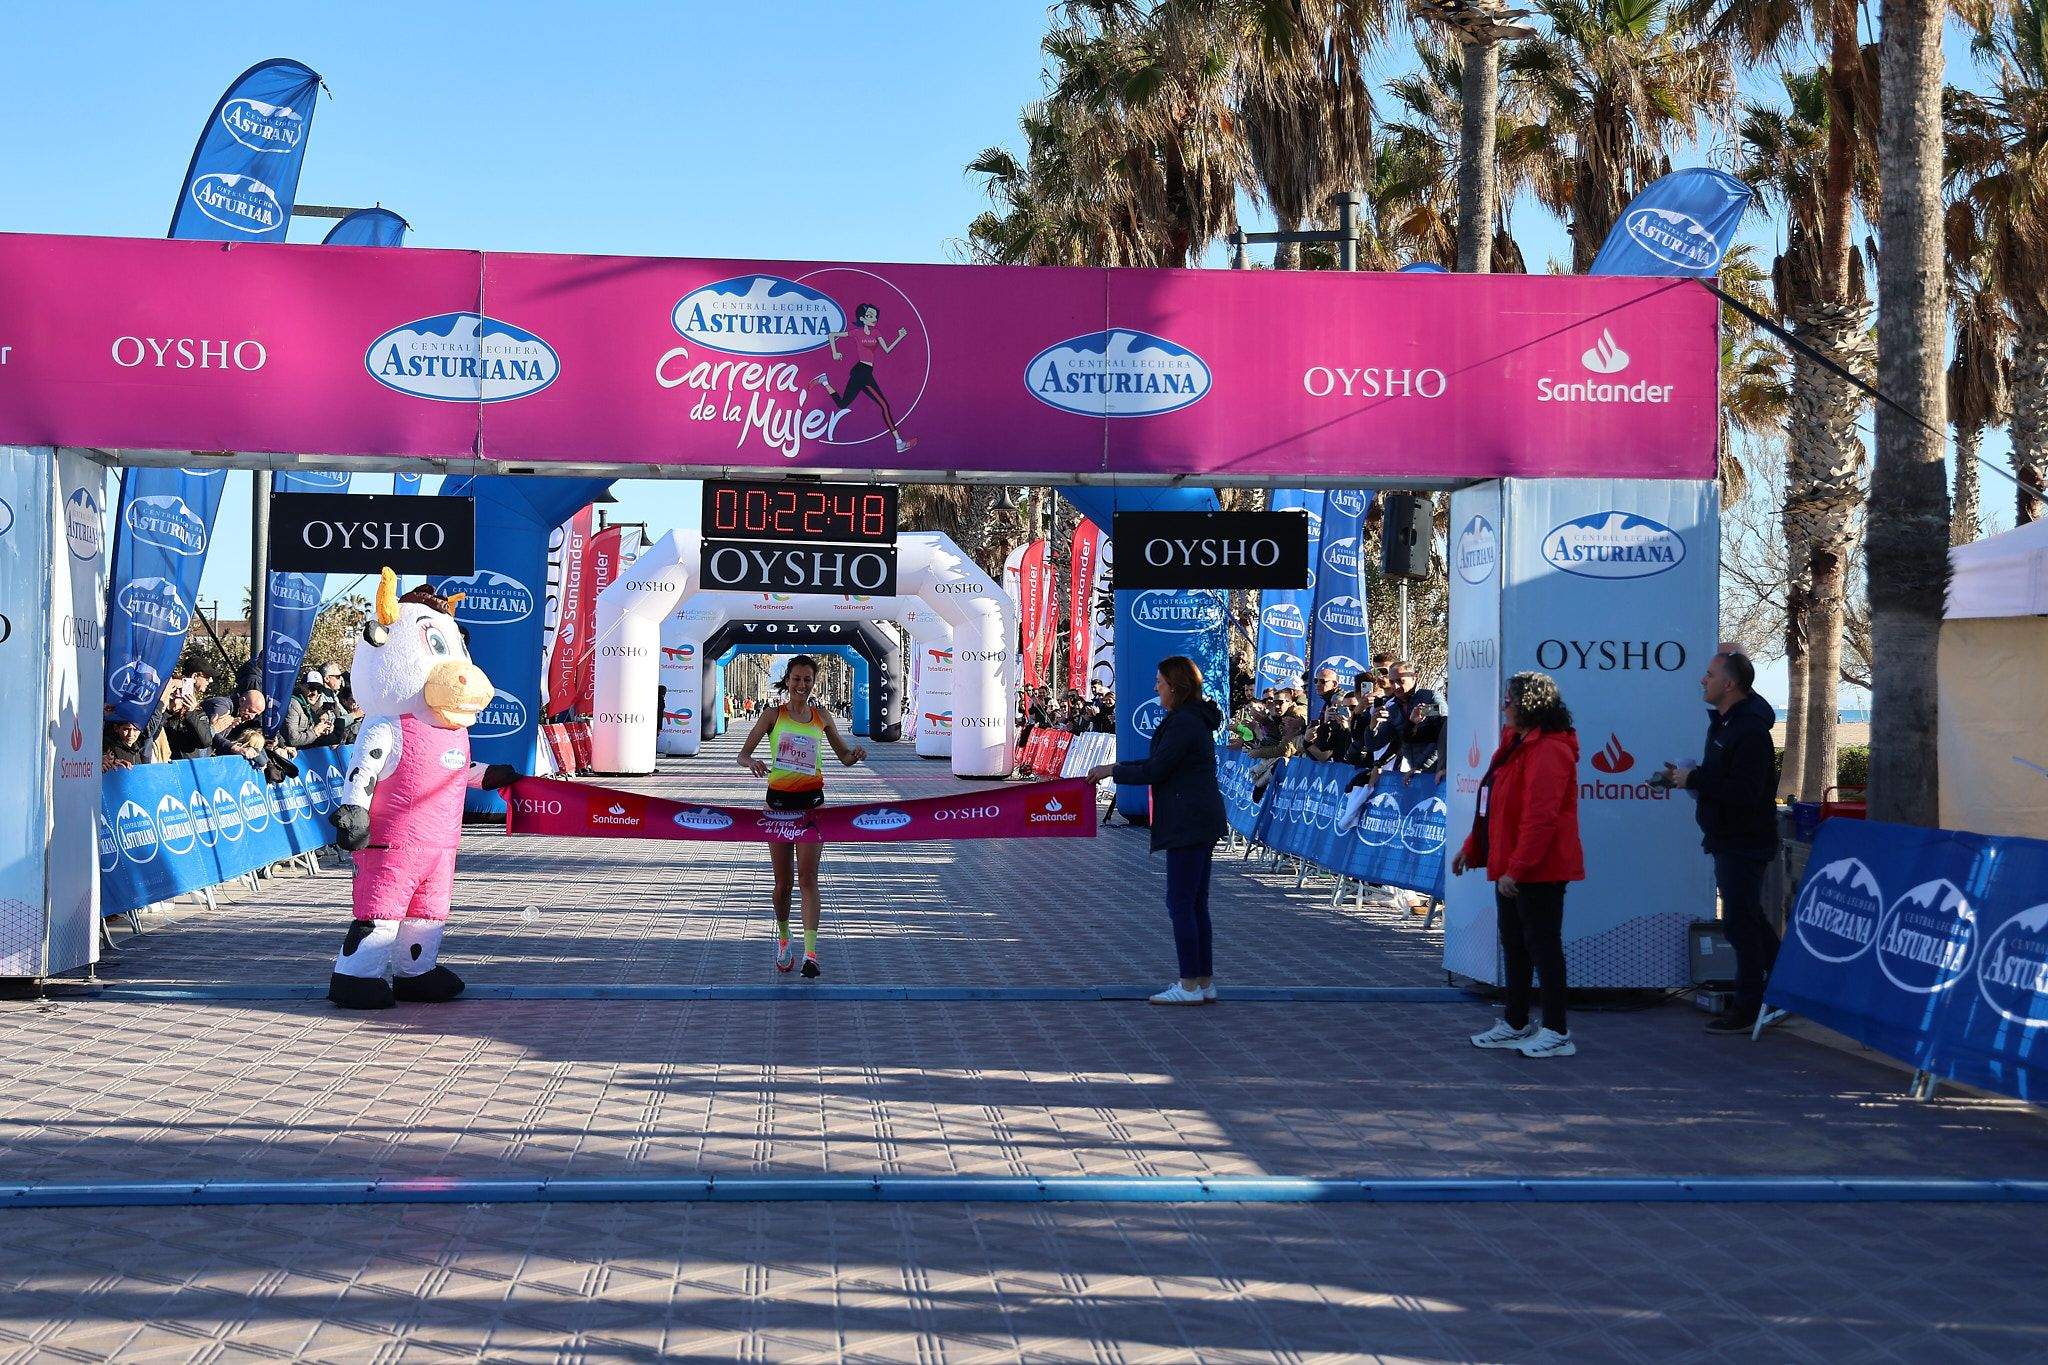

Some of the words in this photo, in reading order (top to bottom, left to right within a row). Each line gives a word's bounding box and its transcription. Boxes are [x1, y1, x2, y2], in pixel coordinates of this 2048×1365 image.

[685, 302, 833, 336] ASTURIANA
[712, 301, 767, 311] CENTRAL
[773, 303, 828, 312] LECHERA
[111, 336, 268, 371] OYSHO
[411, 342, 471, 352] CENTRAL
[380, 343, 545, 381] ASTURIANA
[656, 348, 800, 392] Carrera
[1069, 359, 1126, 368] CENTRAL
[1132, 360, 1191, 368] LECHERA
[1040, 361, 1197, 394] ASTURIANA
[1303, 366, 1447, 398] OYSHO
[1537, 378, 1673, 404] Santander
[690, 393, 717, 422] de
[722, 392, 742, 422] la
[737, 388, 852, 458] Mujer
[716, 489, 884, 535] 00:22:48
[302, 520, 445, 551] OYSHO
[1574, 534, 1618, 542] CENTRAL
[1624, 535, 1671, 543] LECHERA
[1145, 538, 1280, 567] OYSHO
[1552, 536, 1676, 563] ASTURIANA
[565, 532, 583, 620] Santander
[710, 548, 888, 589] OYSHO
[626, 580, 675, 592] OYSHO
[935, 583, 983, 594] OYSHO
[1076, 539, 1091, 627] Santander
[456, 590, 528, 614] TURIANA
[834, 604, 874, 612] TotalEnergies
[744, 624, 841, 633] VOLVO
[602, 646, 647, 657] OYSHO
[962, 651, 1006, 661] OYSHO
[1455, 639, 1494, 670] OYSHO
[1536, 639, 1686, 672] OYSHO
[476, 711, 520, 727] RIANA
[600, 712, 645, 724] OYSHO
[513, 799, 562, 815] YSHO
[934, 805, 1000, 821] OYSHO
[1030, 812, 1076, 822] Santander
[593, 814, 640, 826] Santander
[678, 815, 729, 825] ASTURIANA
[856, 815, 908, 825] ASTURIANA
[1800, 887, 1871, 944] ASTURIANA
[1881, 912, 1966, 971] ASTURIANA
